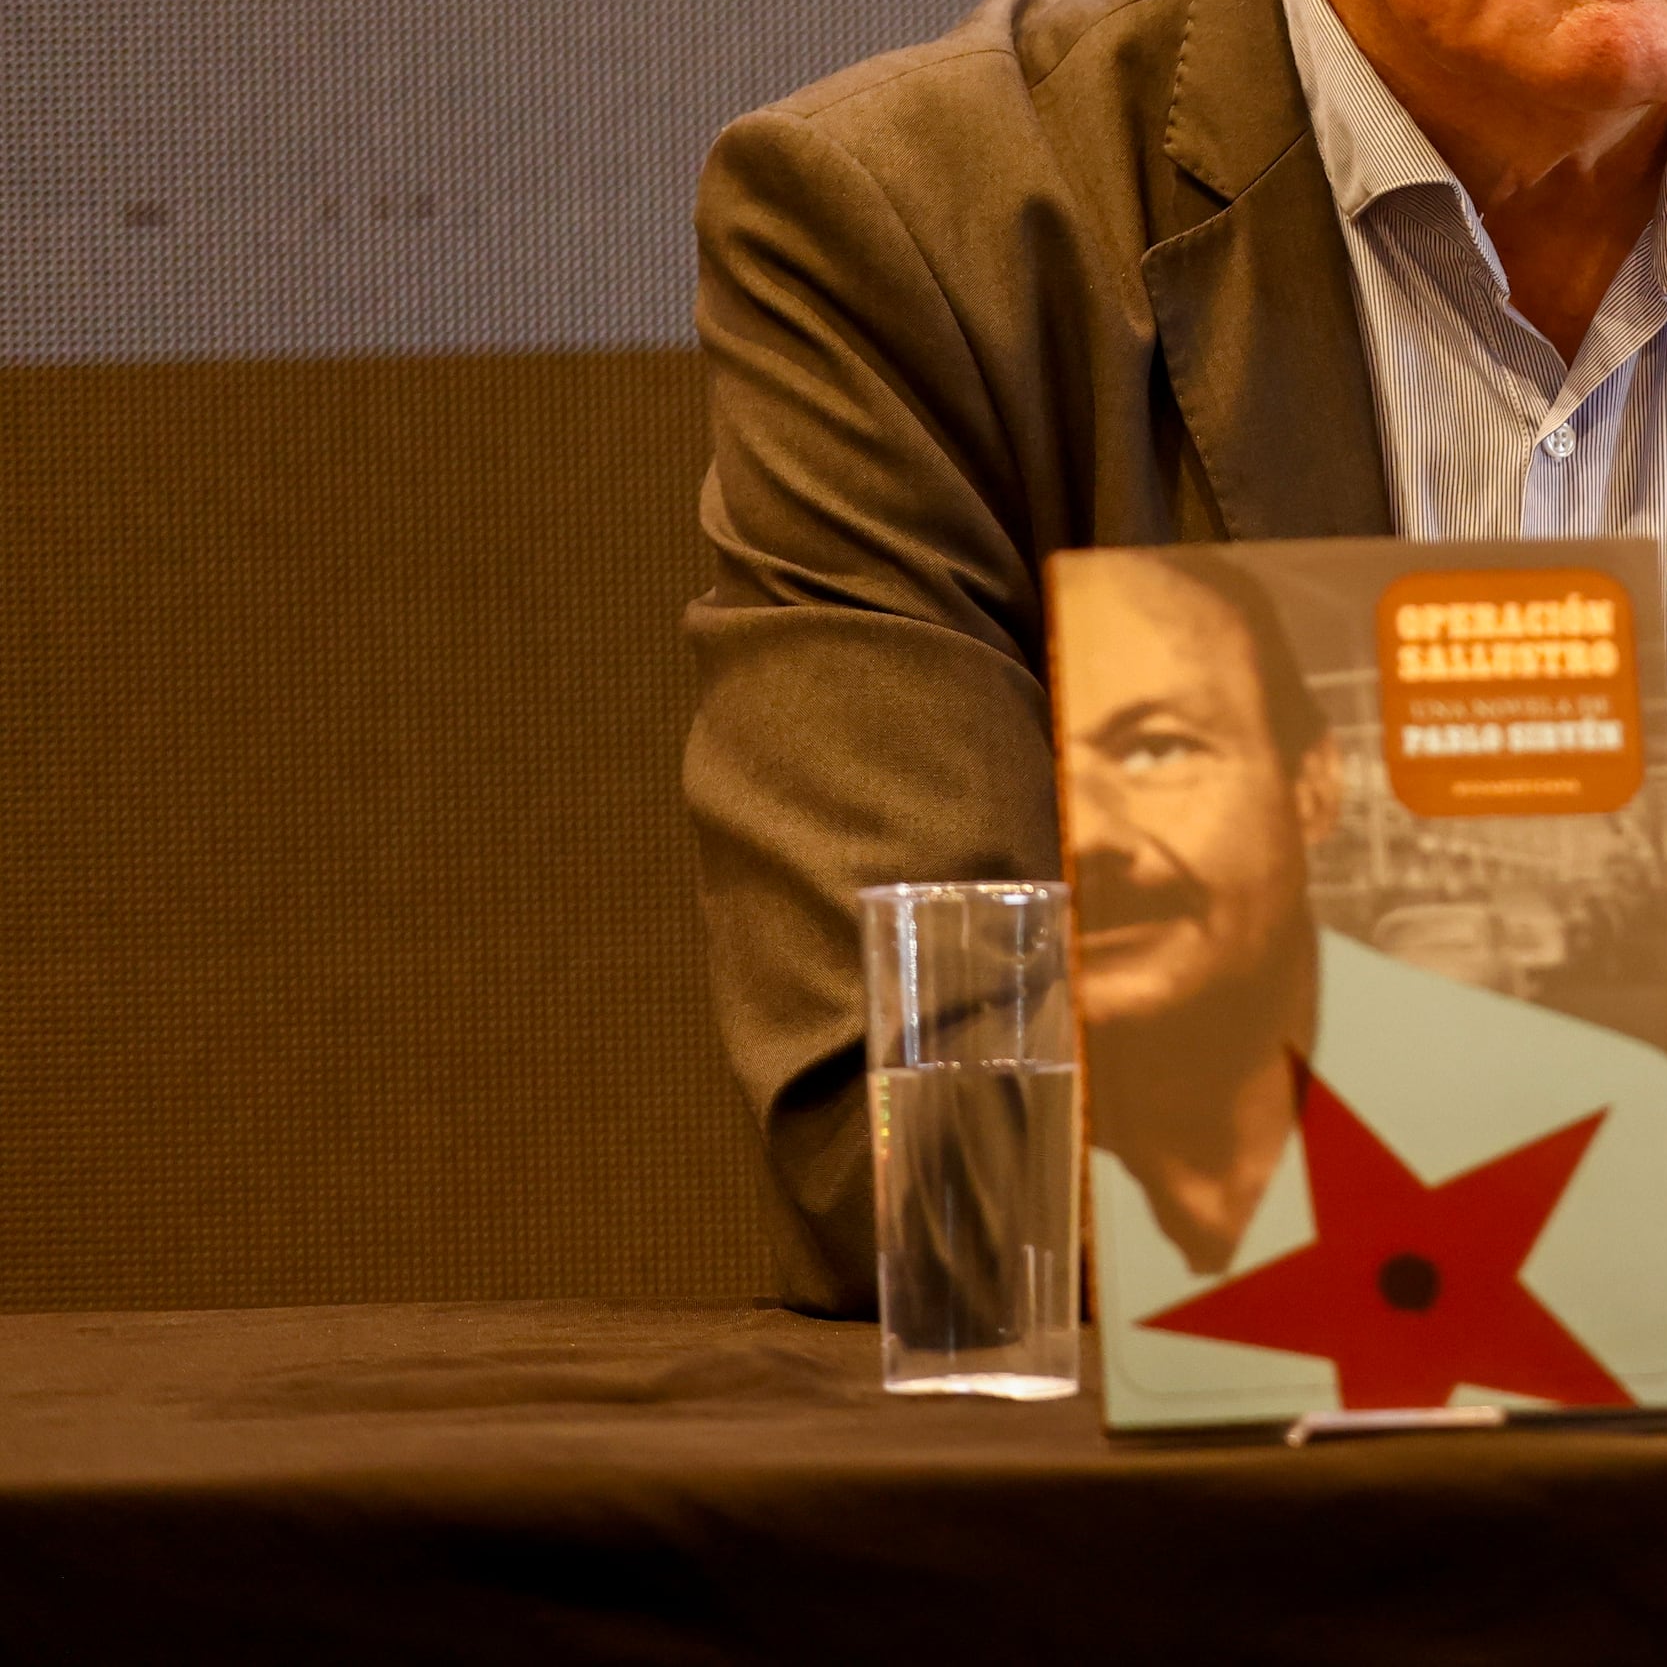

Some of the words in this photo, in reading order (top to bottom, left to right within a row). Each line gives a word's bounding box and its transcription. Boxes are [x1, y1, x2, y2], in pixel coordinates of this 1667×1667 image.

[1397, 593, 1614, 640] OPERACIÓN
[1398, 640, 1619, 683] SALLUSTRO
[1402, 721, 1503, 757] PABLO
